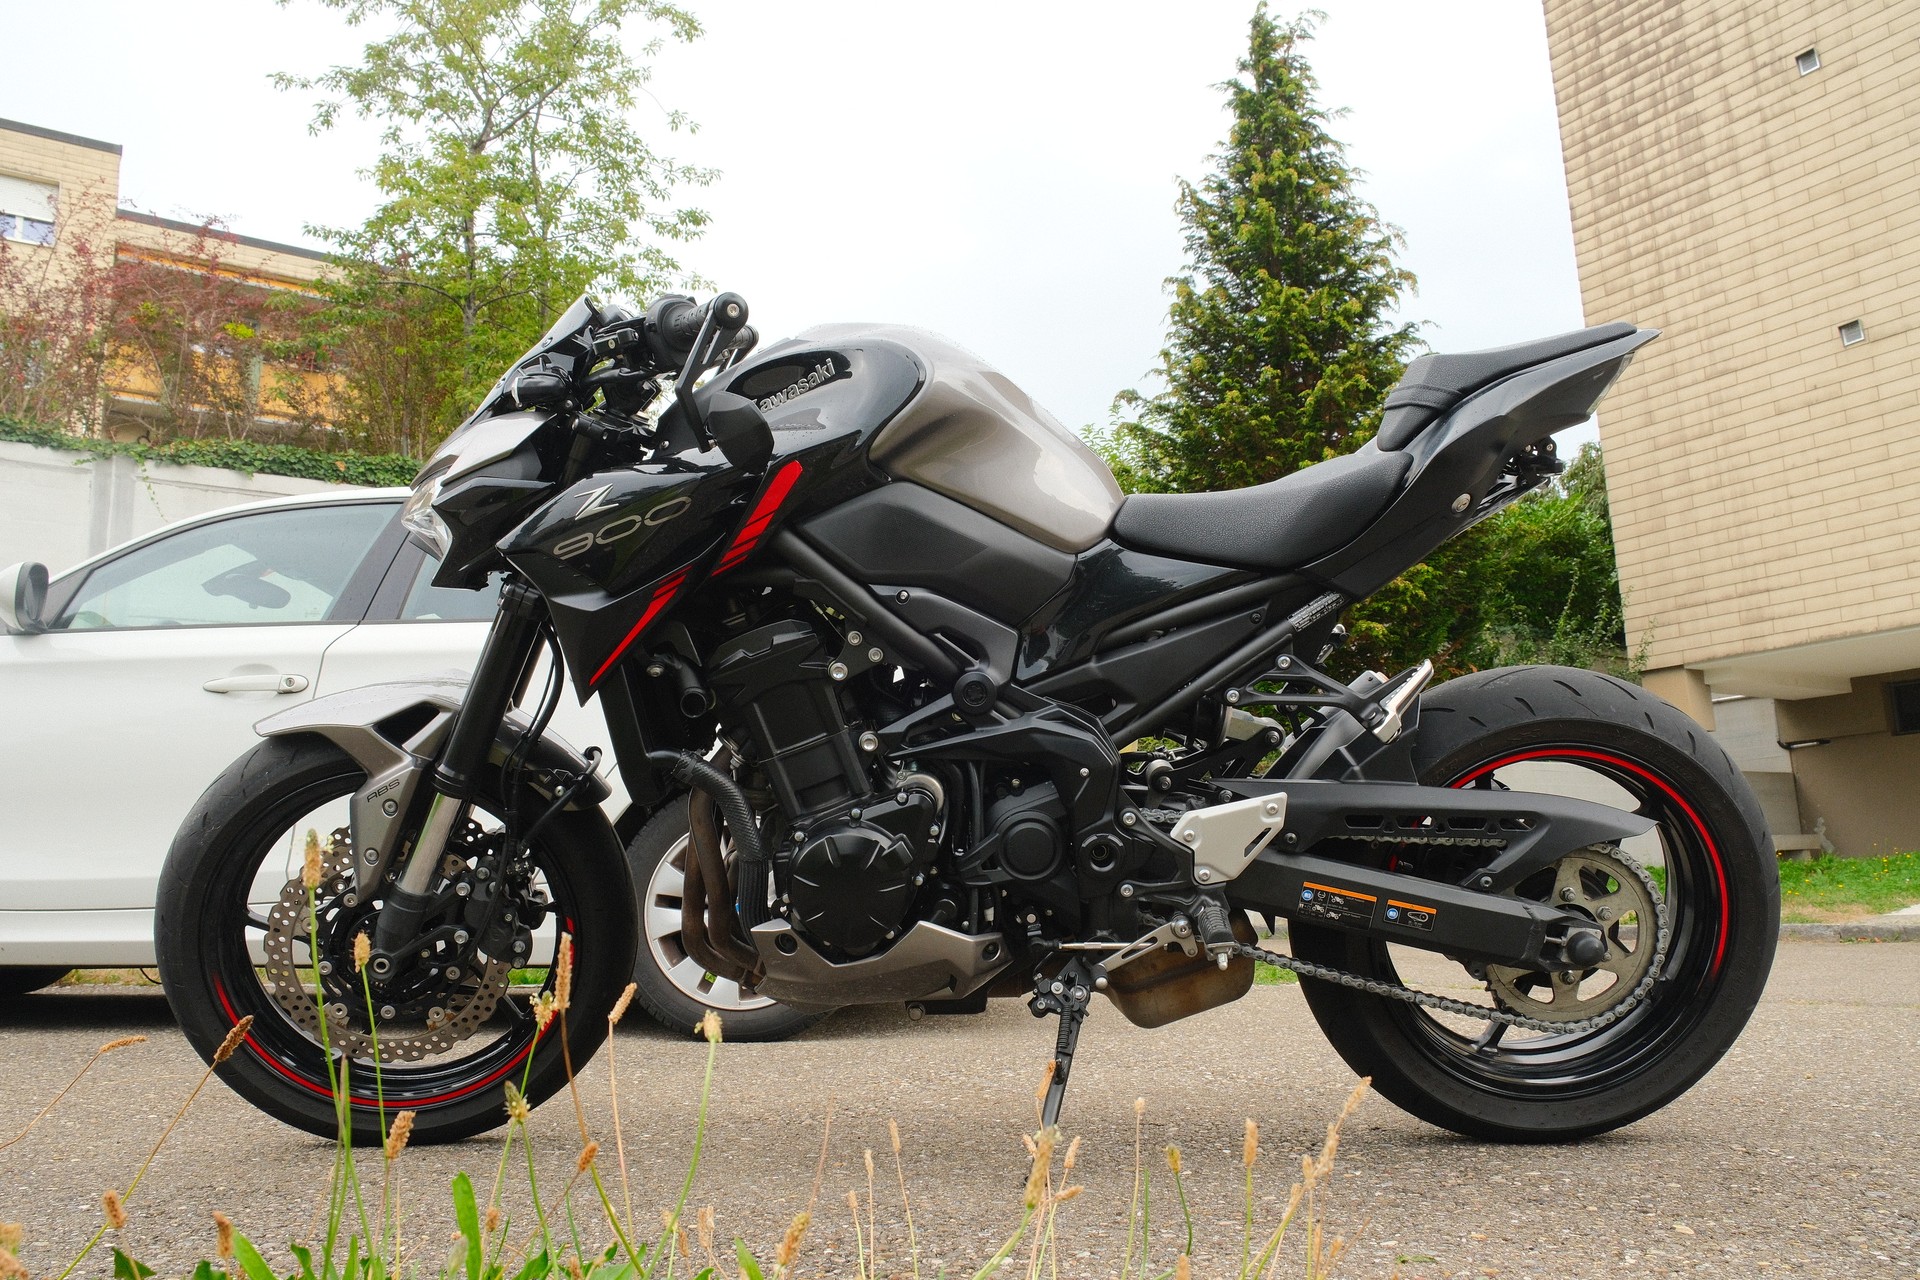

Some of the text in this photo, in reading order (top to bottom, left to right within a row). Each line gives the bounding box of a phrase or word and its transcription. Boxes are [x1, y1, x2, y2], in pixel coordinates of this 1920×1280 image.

[754, 357, 836, 413] awasaki
[574, 483, 619, 521] Z
[553, 496, 692, 561] 900
[366, 778, 400, 803] ABS
